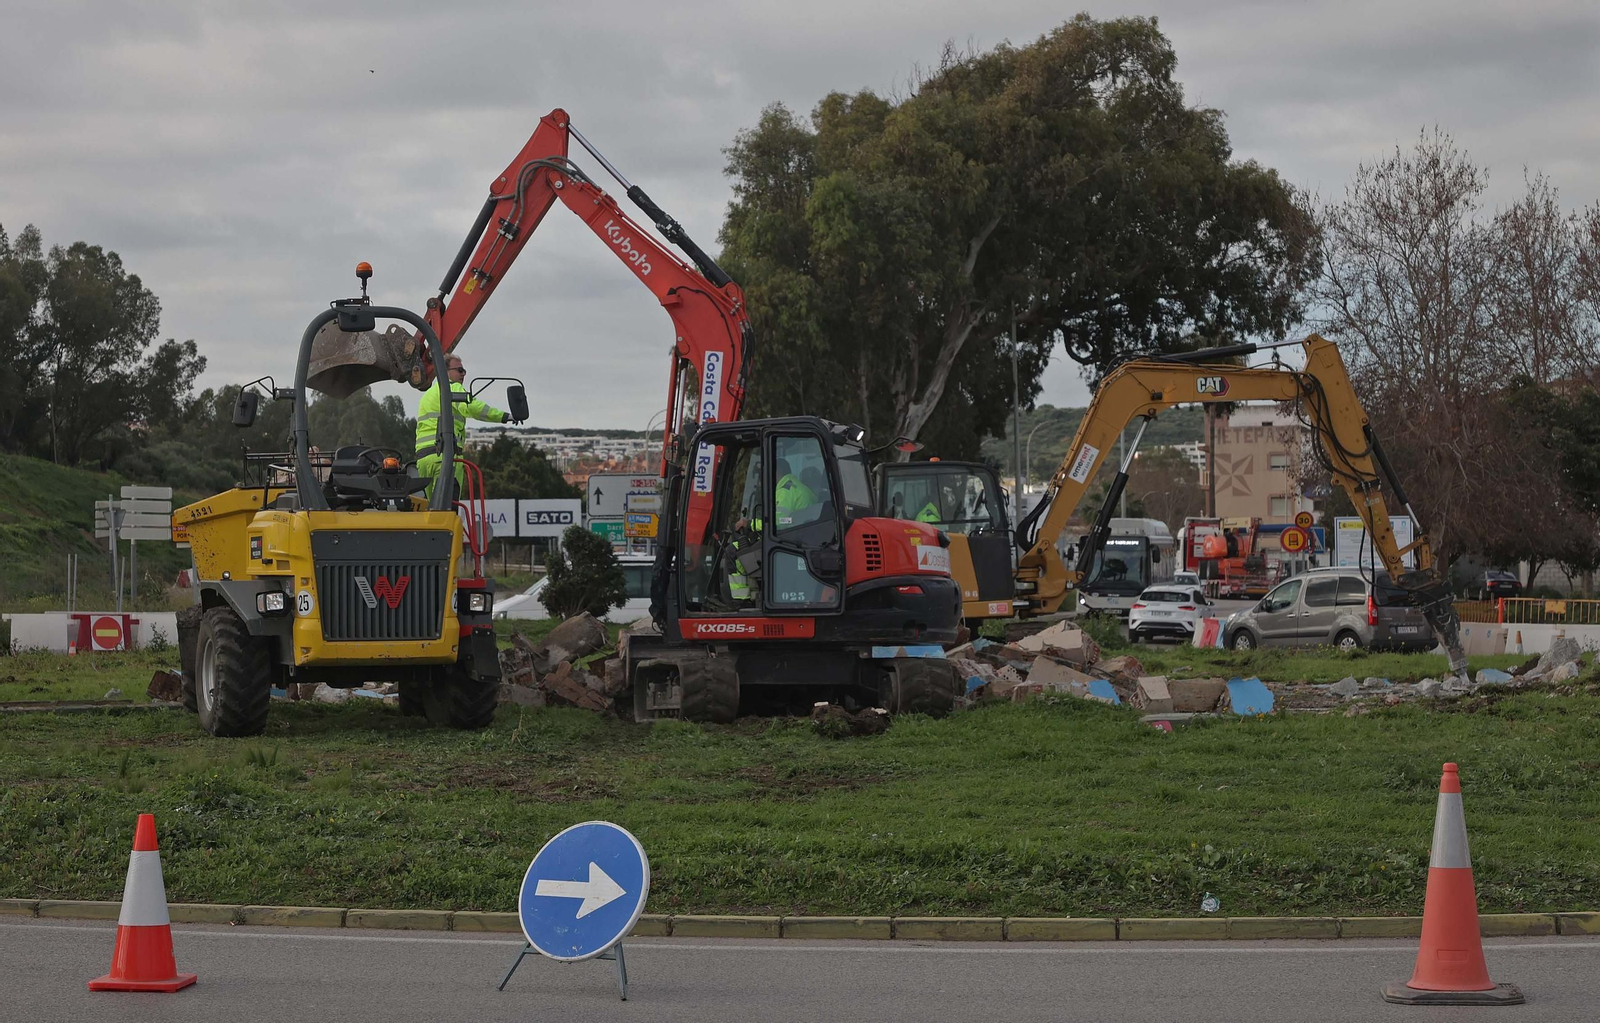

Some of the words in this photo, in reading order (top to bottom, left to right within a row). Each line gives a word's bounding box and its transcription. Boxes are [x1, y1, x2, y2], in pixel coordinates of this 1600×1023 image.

[604, 219, 652, 276] Kubota
[704, 352, 720, 395] Costa
[1197, 376, 1222, 393] CAT
[696, 456, 711, 491] Rent
[528, 512, 572, 524] SATO
[1298, 517, 1310, 525] 30
[298, 594, 309, 612] 25
[781, 591, 805, 601] 025
